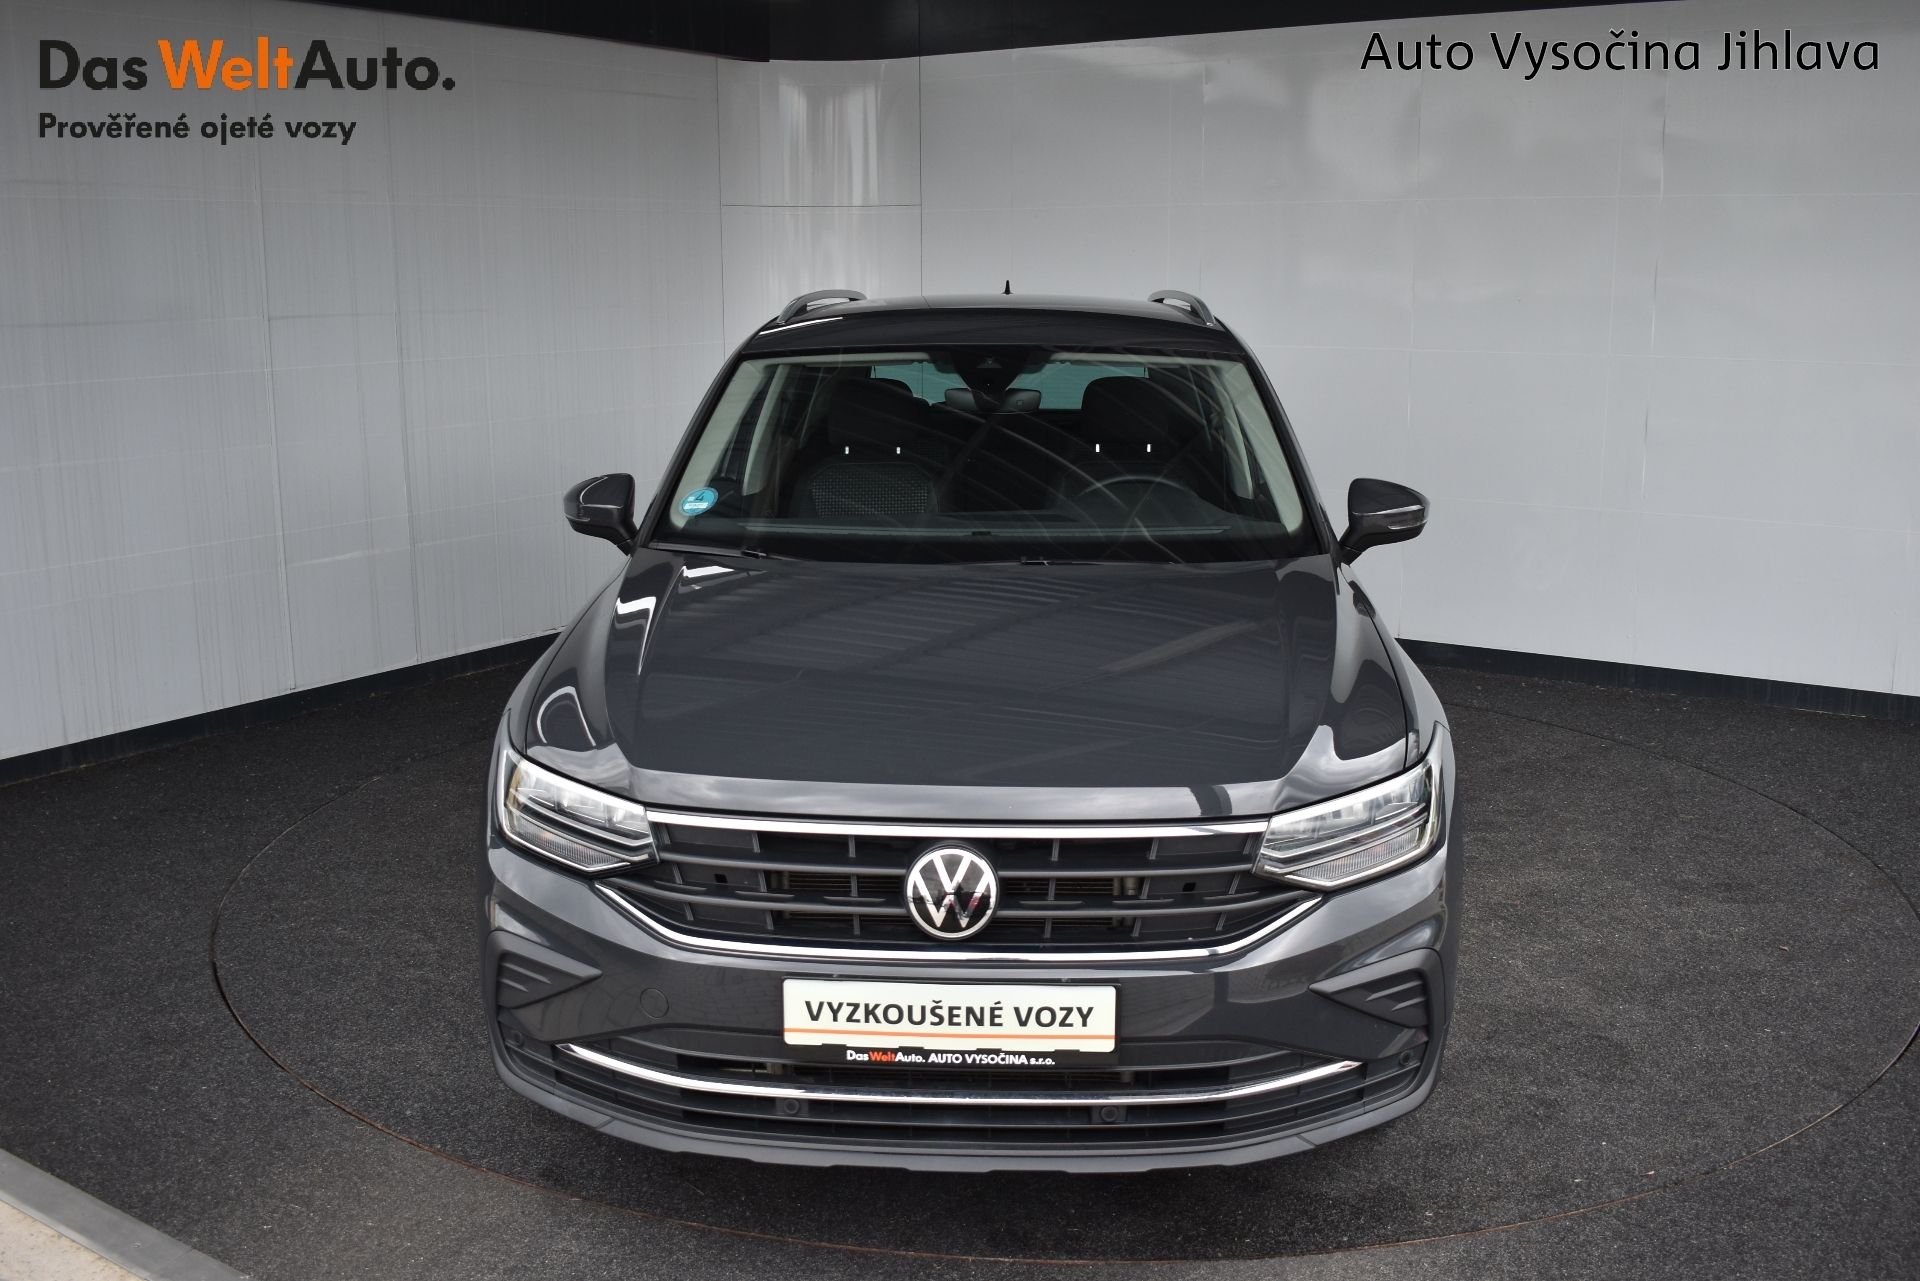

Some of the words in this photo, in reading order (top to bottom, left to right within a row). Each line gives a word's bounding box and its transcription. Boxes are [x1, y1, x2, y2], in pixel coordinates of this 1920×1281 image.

[804, 1000, 1004, 1027] VYZKOUŠENÉ
[1013, 1006, 1094, 1028] VOZY
[927, 1053, 963, 1064] AUTO
[964, 1052, 1028, 1065] VYSOČINA
[1029, 1057, 1055, 1065] s.r.o.
